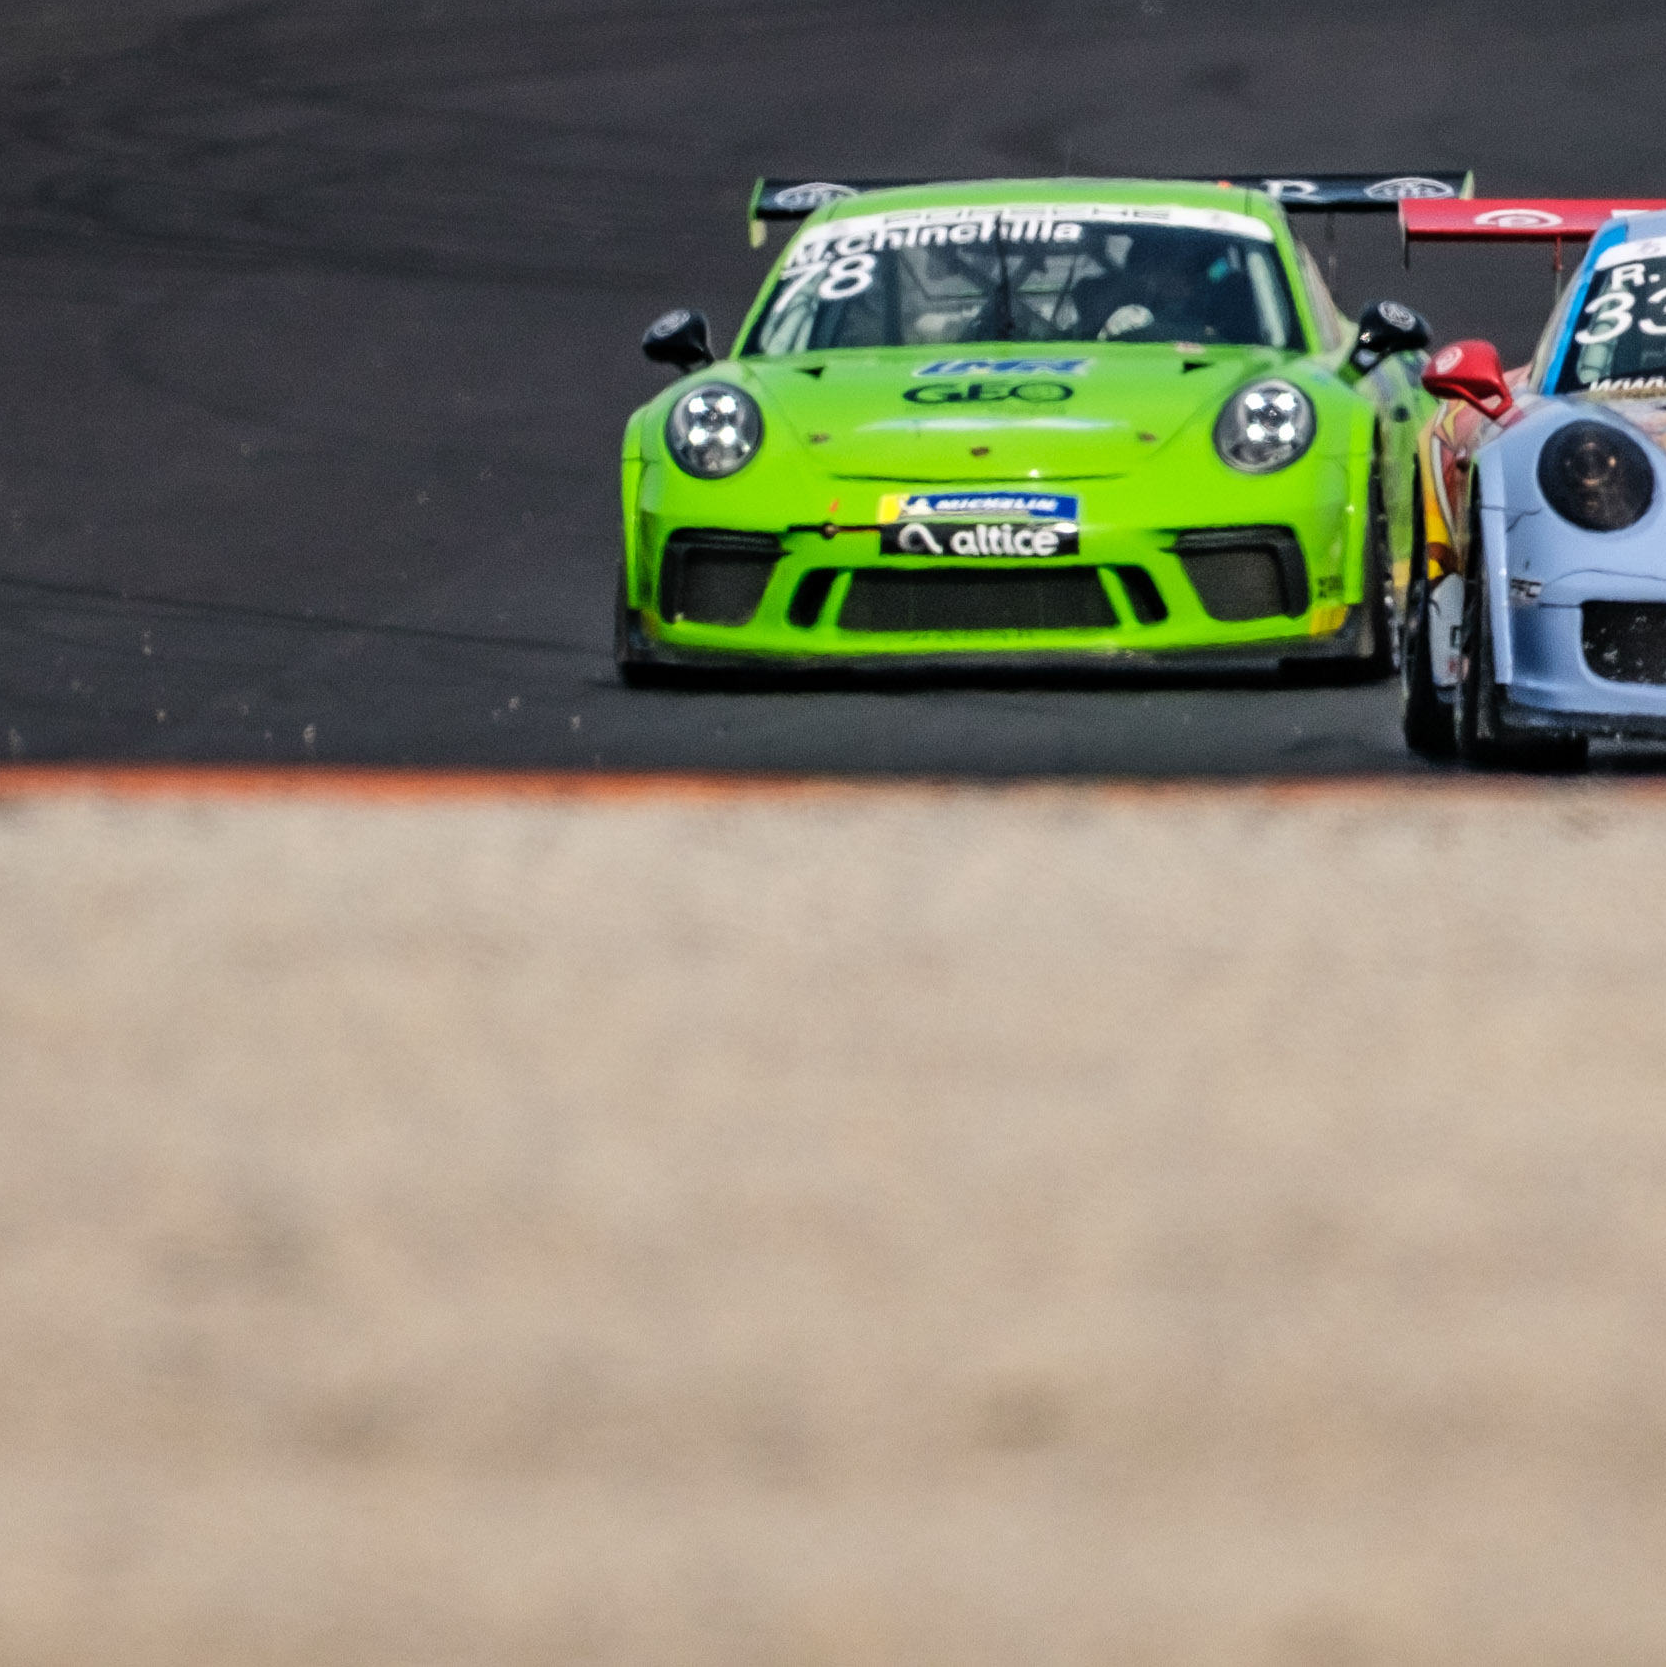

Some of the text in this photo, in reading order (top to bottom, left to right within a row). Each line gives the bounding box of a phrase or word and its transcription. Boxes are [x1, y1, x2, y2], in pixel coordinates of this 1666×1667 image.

[773, 253, 876, 313] 78
[902, 383, 1074, 404] GEO
[935, 497, 1059, 512] MICHELIN
[949, 523, 1060, 556] altice
